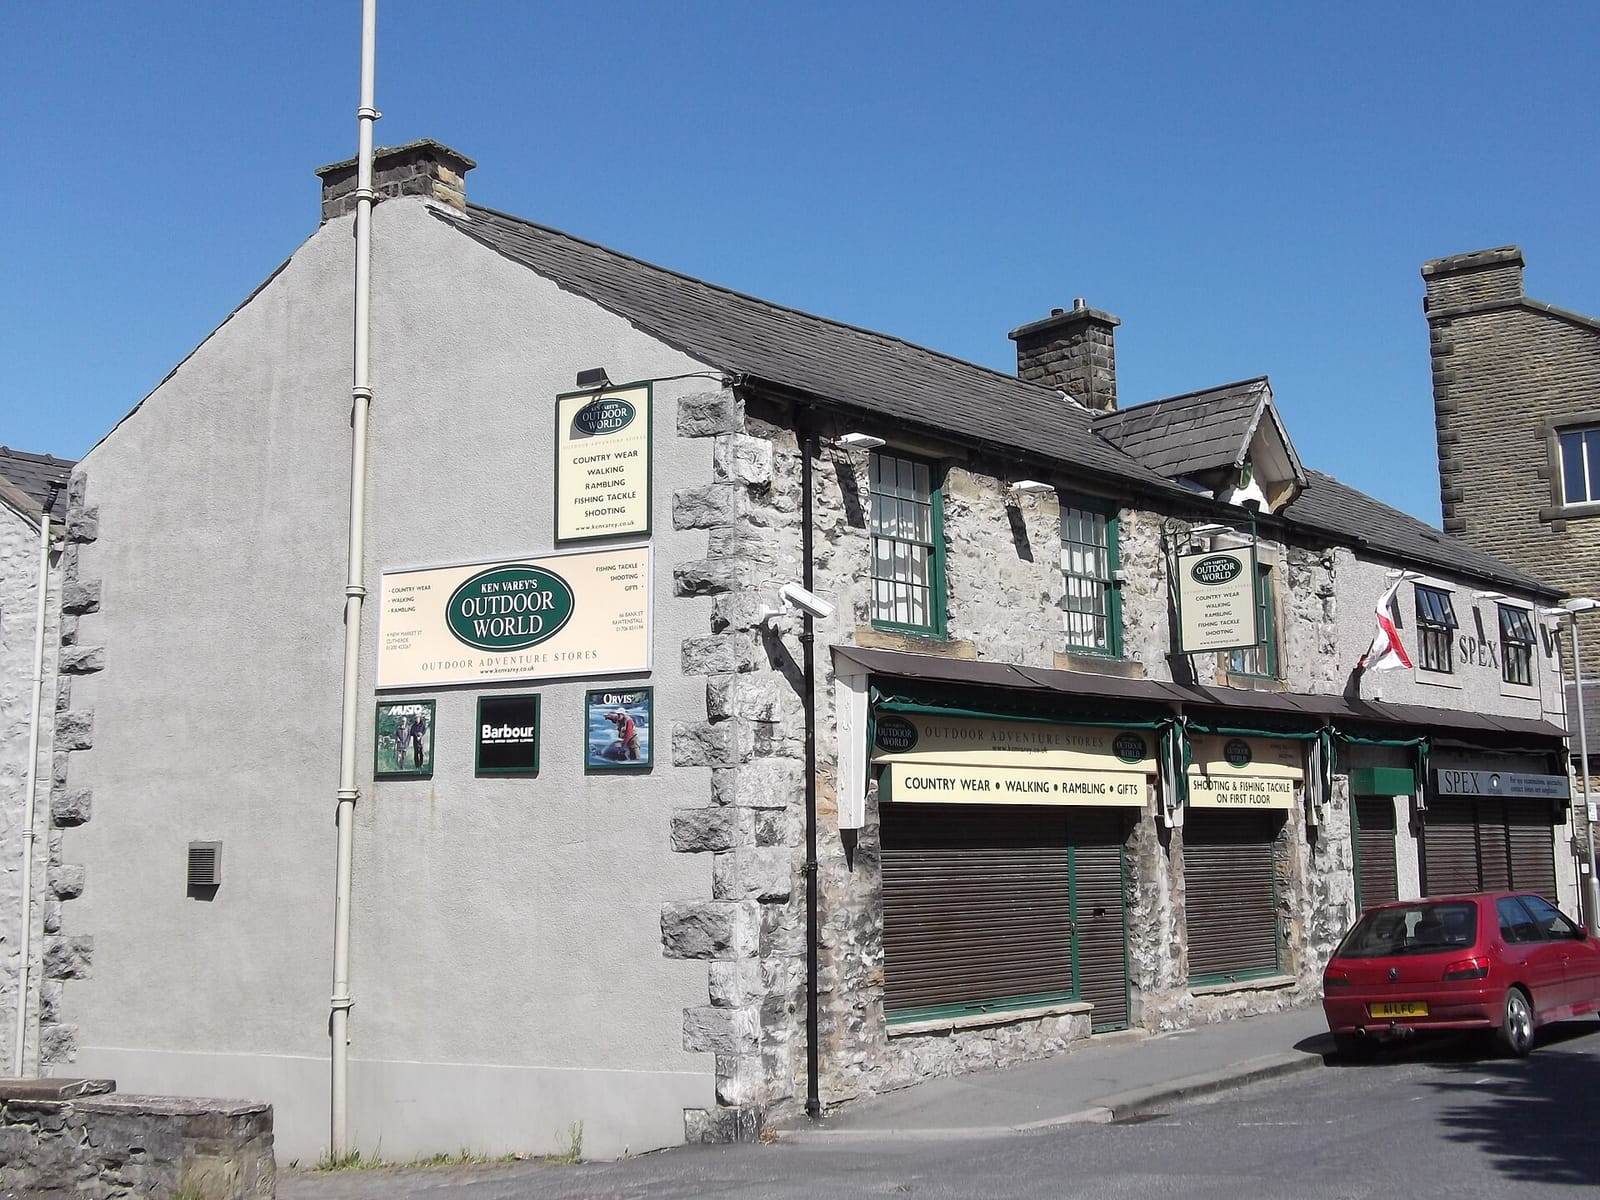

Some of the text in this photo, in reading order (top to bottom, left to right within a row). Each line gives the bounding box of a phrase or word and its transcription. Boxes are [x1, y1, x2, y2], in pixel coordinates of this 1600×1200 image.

[582, 408, 627, 422] OUTDOOR
[588, 417, 622, 430] WORLD
[573, 450, 638, 464] COUNTRY WEAR
[587, 466, 624, 476] WALKING
[585, 479, 626, 490] RAMBLING
[574, 491, 636, 504] FISHING TACKLE
[584, 506, 626, 517] SHOOTING
[1196, 563, 1235, 574] OUTDOOR
[1202, 572, 1231, 582] WORLD
[481, 579, 538, 594] KEN VAREY'S
[461, 590, 555, 618] OUTDOOR
[473, 615, 543, 639] WORLD
[1459, 634, 1500, 670] SPEX
[422, 650, 598, 671] OUTDOOR ADVENTURE STORES
[480, 665, 534, 674] www.kenvarey.co.uk
[388, 704, 423, 716] MUSTO
[482, 724, 534, 739] Barbour
[878, 727, 912, 738] OUTDOOR
[925, 726, 1104, 747] OUTDOOR ADVENTURE STORES
[882, 736, 908, 746] WORLD
[904, 777, 1138, 795] COUNTRY WEAR WALKING RAMBLING GIFTS
[1193, 780, 1290, 792] SHOOTING & FISHING TACKLE
[1445, 770, 1480, 793] SPEX
[1216, 794, 1270, 804] ON FIRST FLOOR
